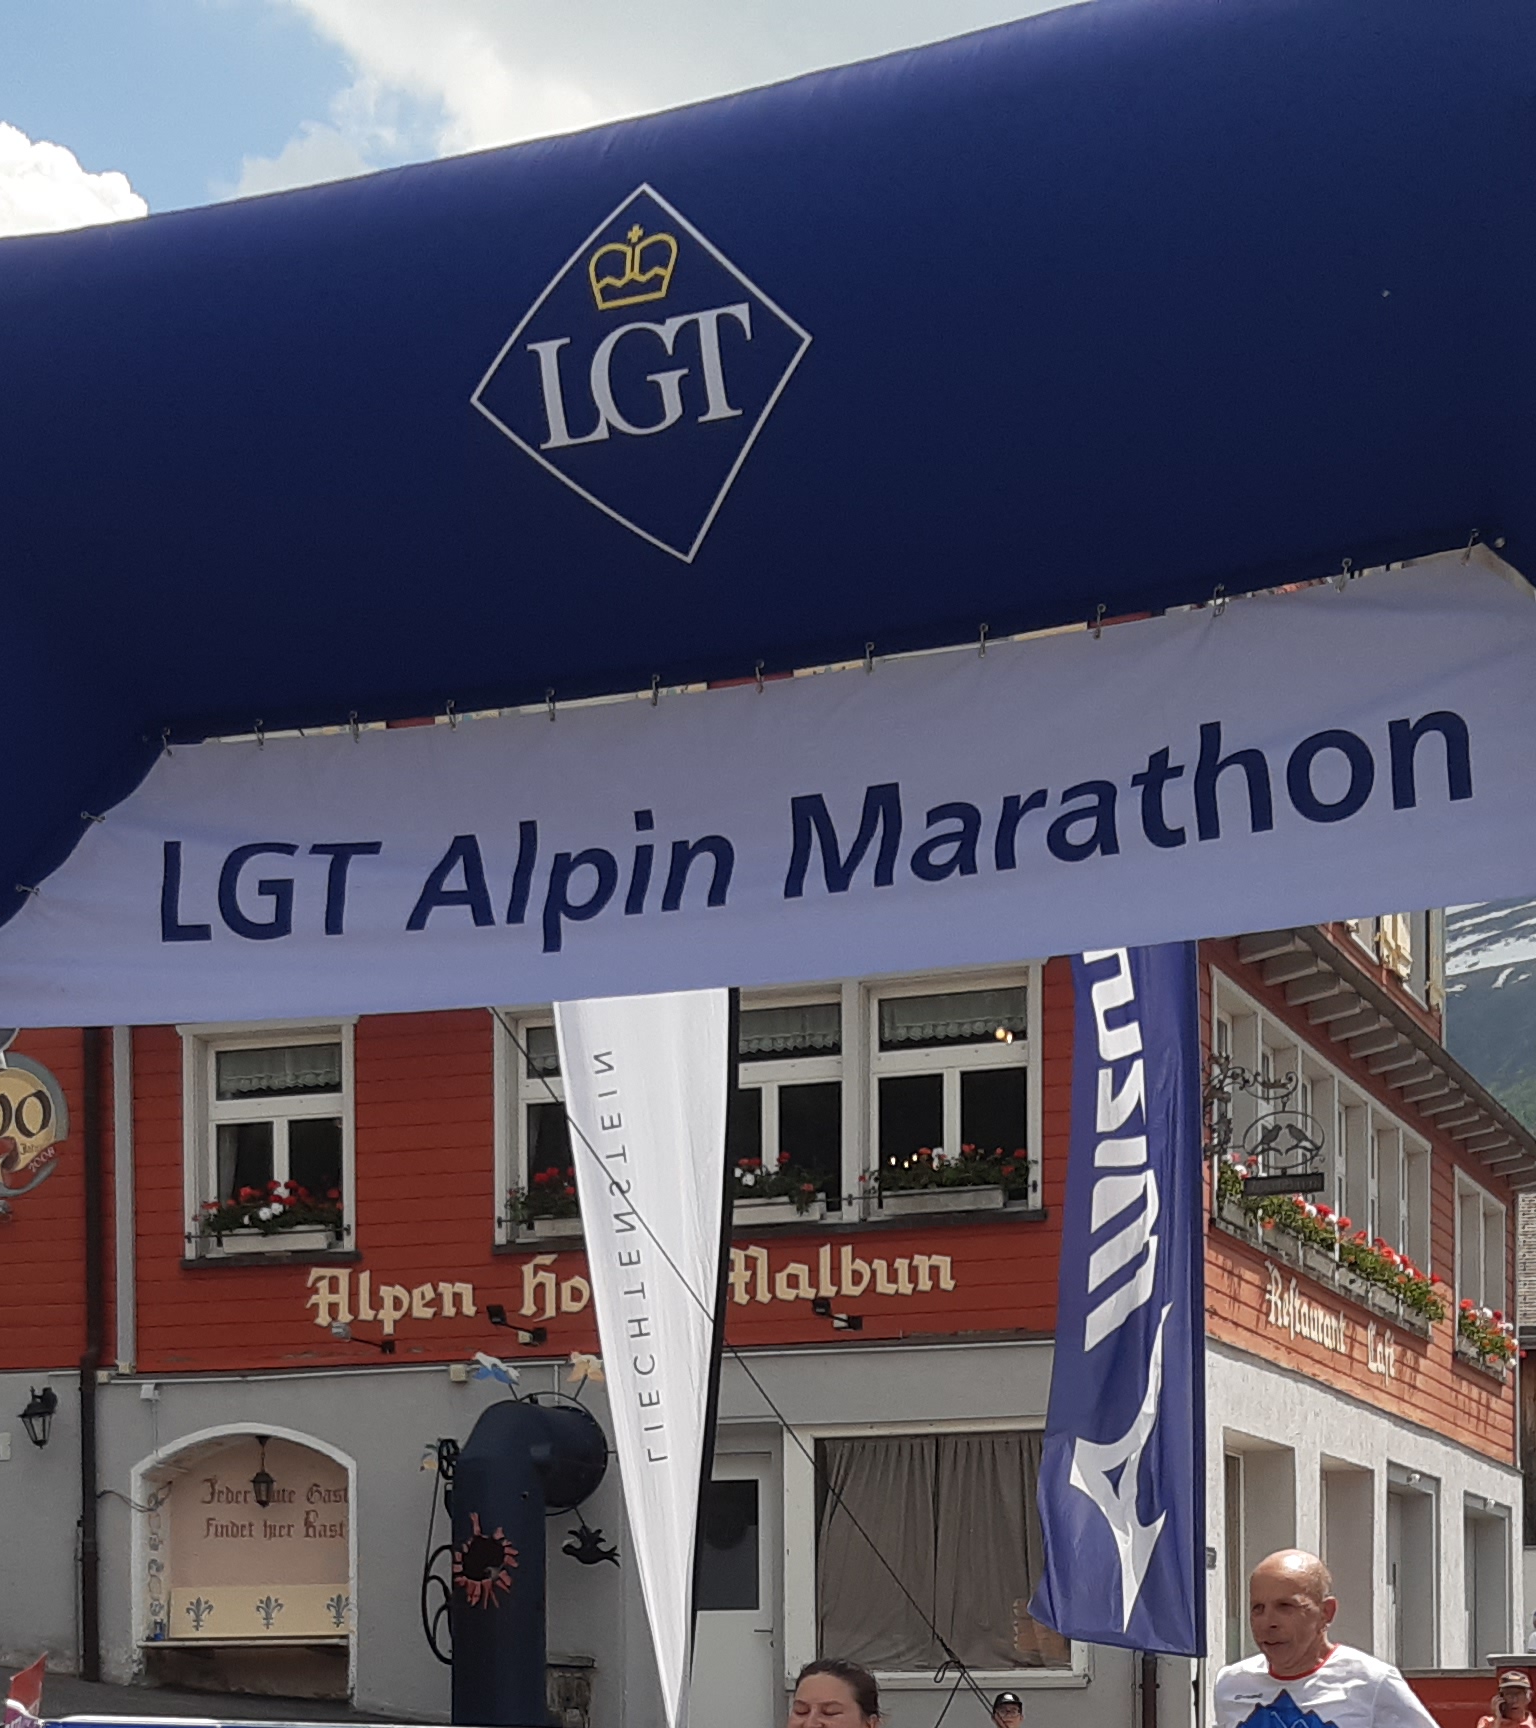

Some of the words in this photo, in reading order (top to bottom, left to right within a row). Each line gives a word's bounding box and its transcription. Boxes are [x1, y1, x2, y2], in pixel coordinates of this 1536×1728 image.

[526, 302, 752, 449] LGT
[161, 840, 382, 942] LGT
[405, 809, 735, 953] Alpin
[784, 710, 1474, 899] Marathon
[305, 1265, 478, 1336] Alpen
[518, 1254, 591, 1324] Ho
